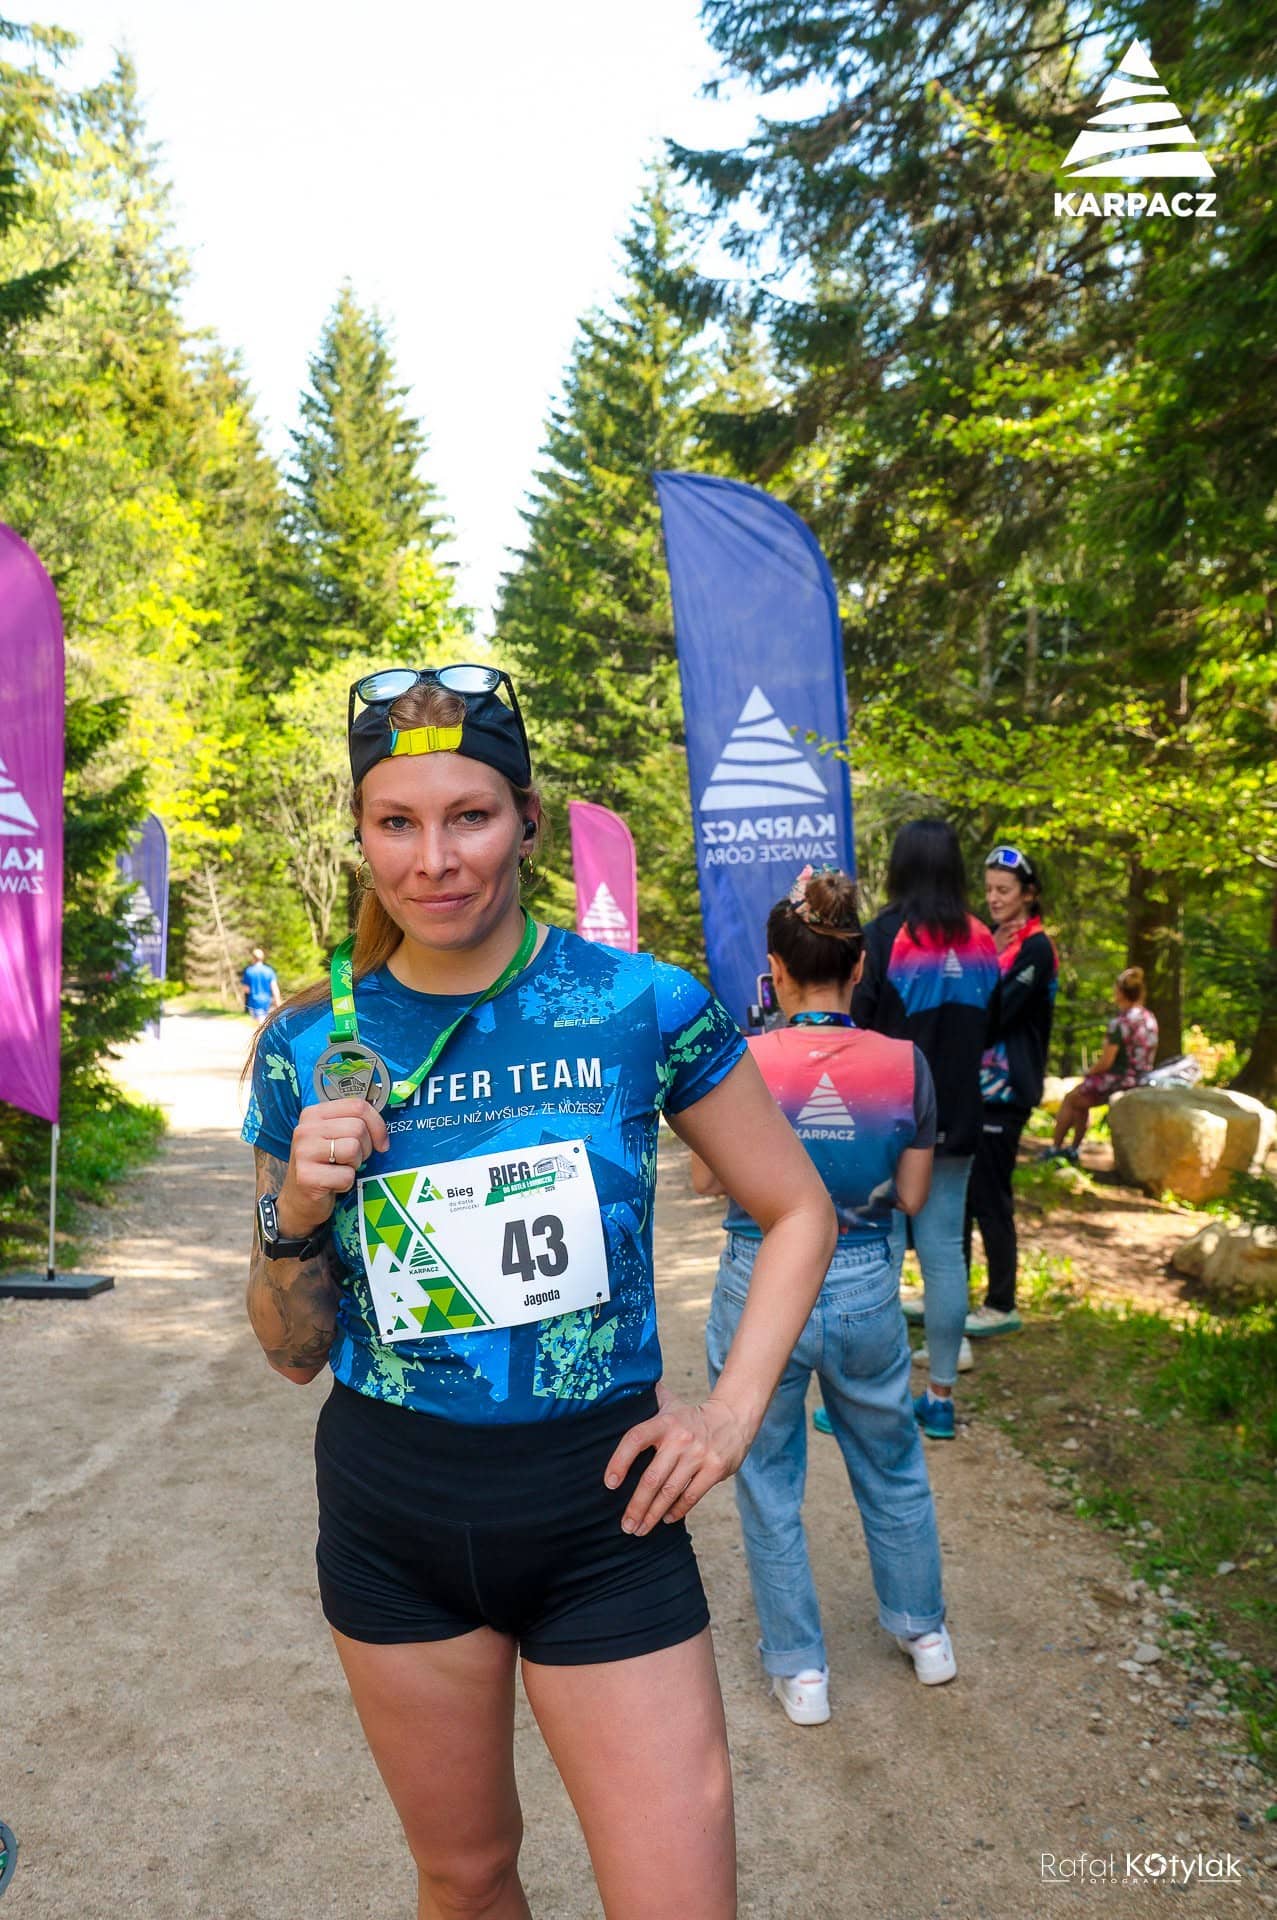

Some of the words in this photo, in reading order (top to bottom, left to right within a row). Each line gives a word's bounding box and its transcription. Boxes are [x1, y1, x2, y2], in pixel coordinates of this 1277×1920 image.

[507, 1056, 603, 1095] TEAM
[416, 1114, 460, 1131] WIĘCEJ
[463, 1110, 482, 1124] NIŻ
[541, 1102, 555, 1114] ŻE
[795, 1128, 856, 1141] KARPACZ
[488, 1161, 531, 1193] BIEG
[446, 1186, 474, 1199] Bieg
[501, 1214, 569, 1283] 43
[408, 1266, 440, 1276] KARPACZ
[523, 1288, 561, 1308] Jagoda
